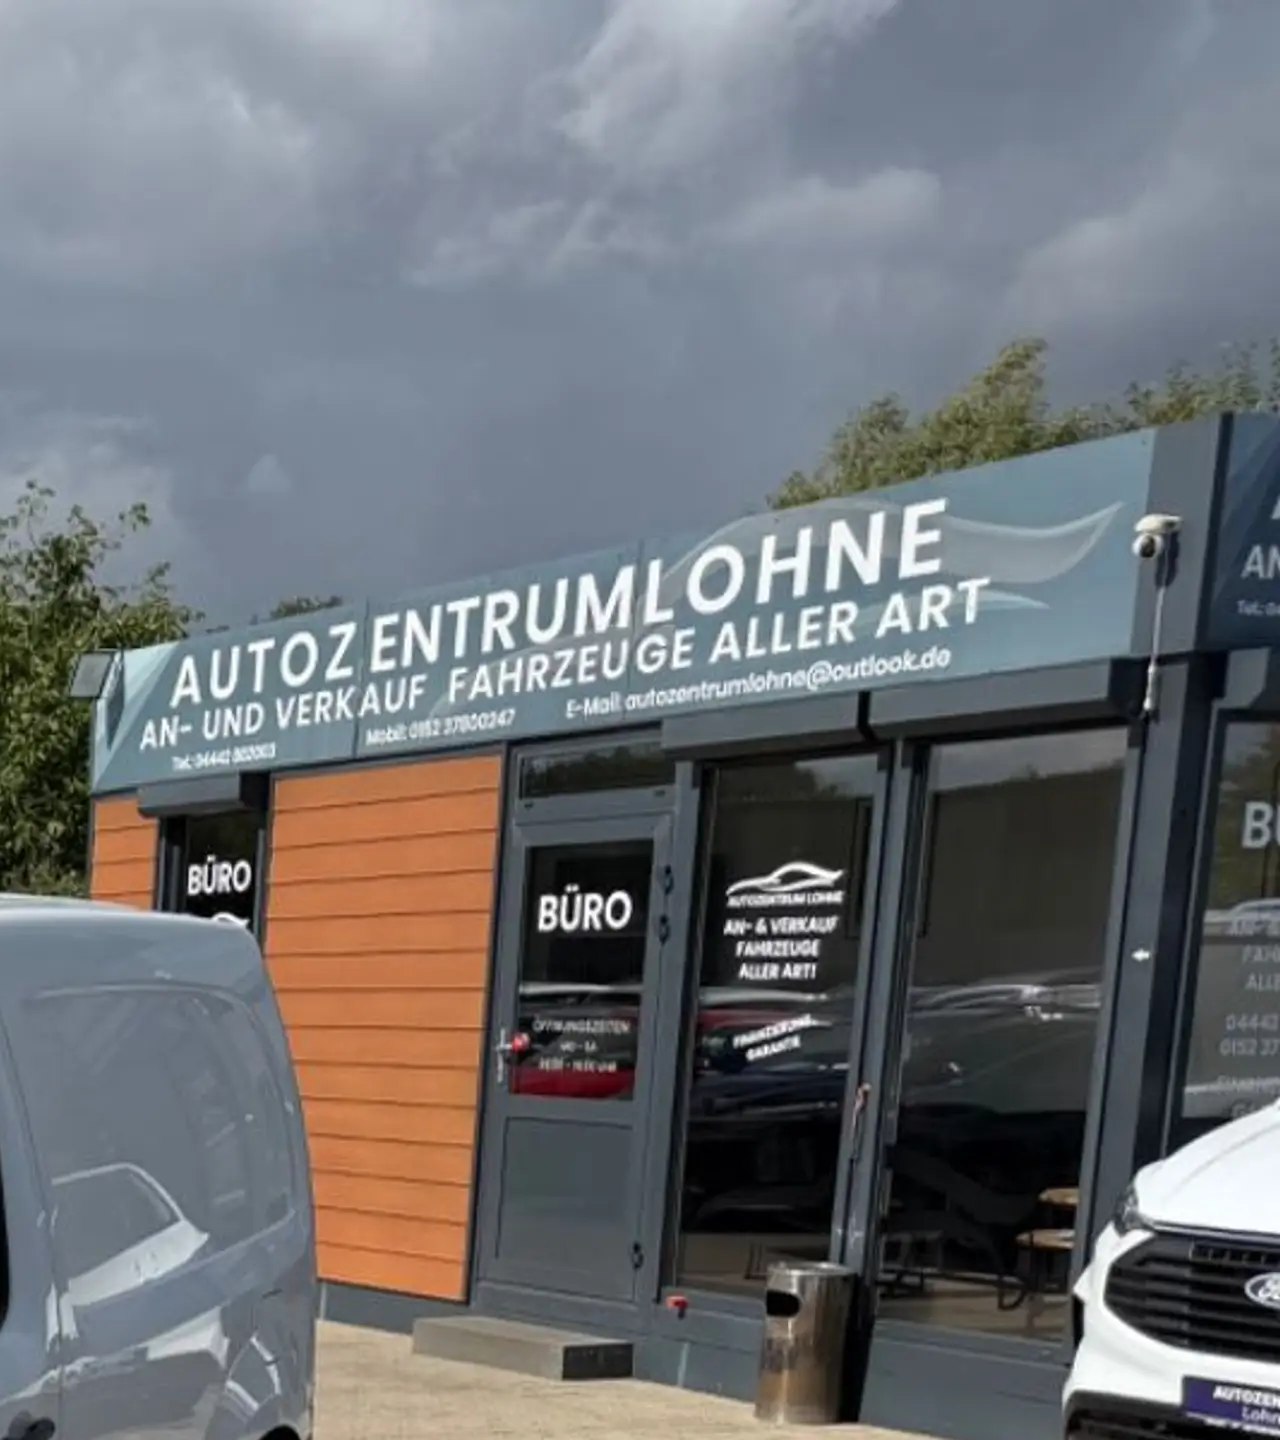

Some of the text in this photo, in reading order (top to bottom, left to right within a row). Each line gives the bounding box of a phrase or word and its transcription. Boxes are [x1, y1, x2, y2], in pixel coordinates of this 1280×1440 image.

[140, 577, 991, 751] AN- UND VERKAUF FAHRZEUGE ALLER ART
[624, 645, 953, 712] autozentrumlohne@outlook.de
[1242, 800, 1280, 849] B
[187, 855, 252, 896] BÜRO
[538, 883, 633, 932] BÜRO
[724, 915, 839, 935] AN- & VERKAUF
[735, 938, 821, 957] FAHRZEUGE
[738, 963, 780, 980] ALLER
